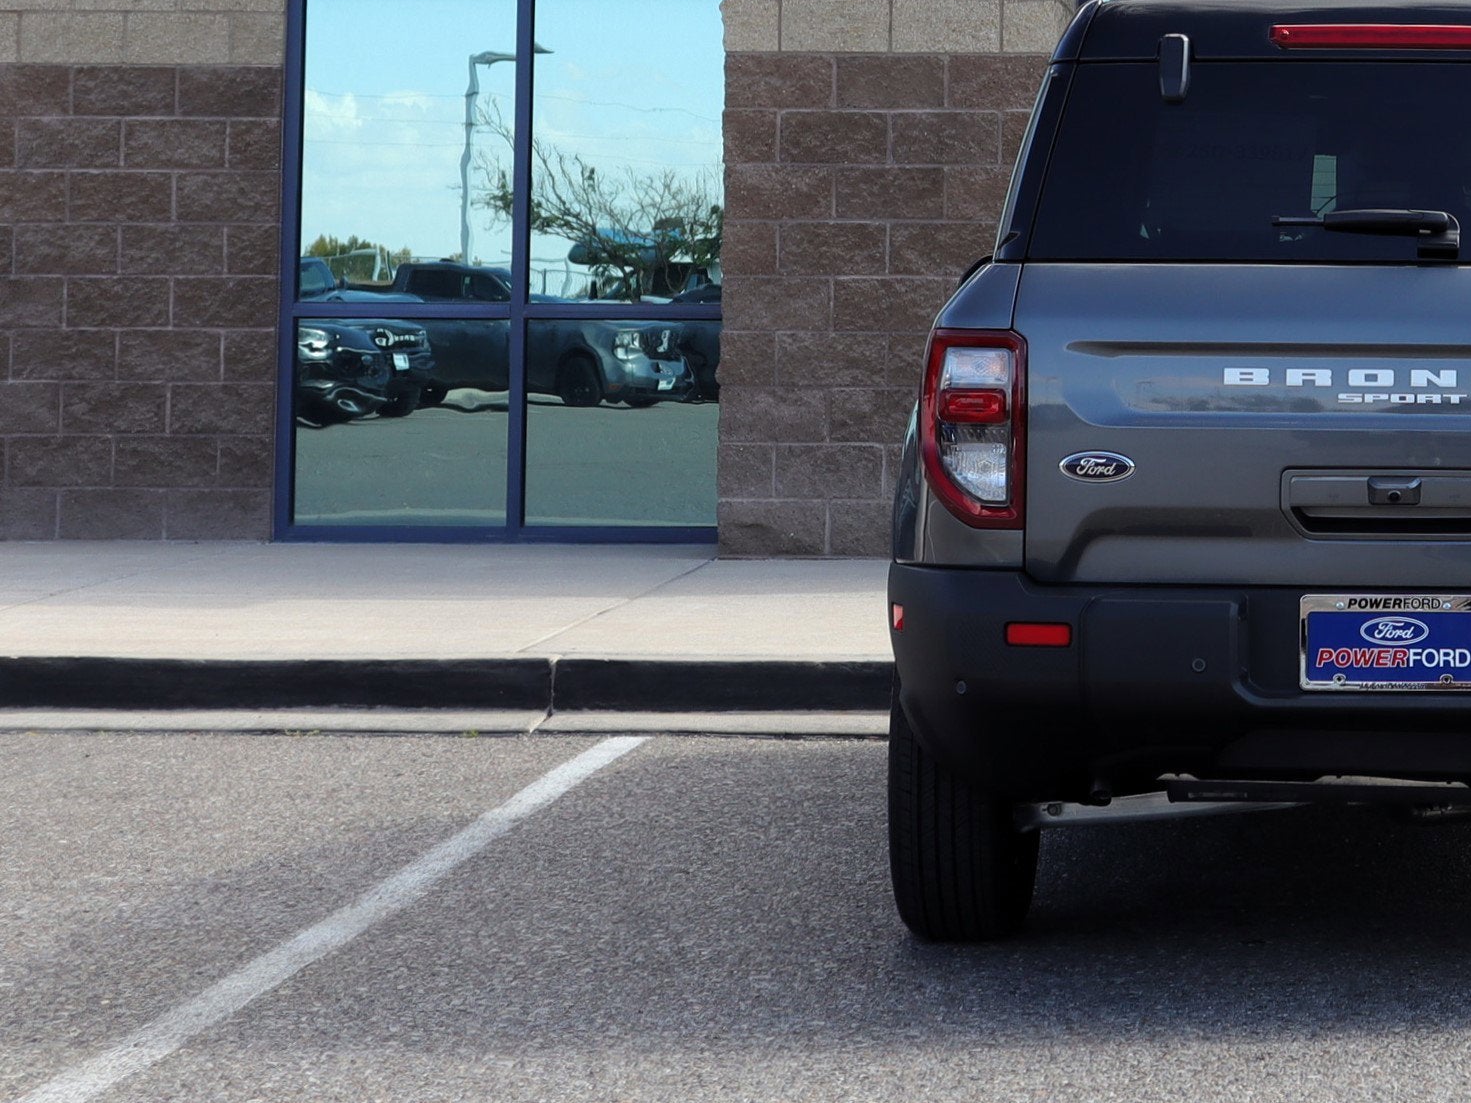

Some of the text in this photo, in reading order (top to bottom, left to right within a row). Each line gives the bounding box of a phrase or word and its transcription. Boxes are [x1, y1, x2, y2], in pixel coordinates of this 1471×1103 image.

[1337, 392, 1467, 405] SPORT
[1076, 457, 1117, 477] Ford
[1374, 621, 1415, 639] Ford
